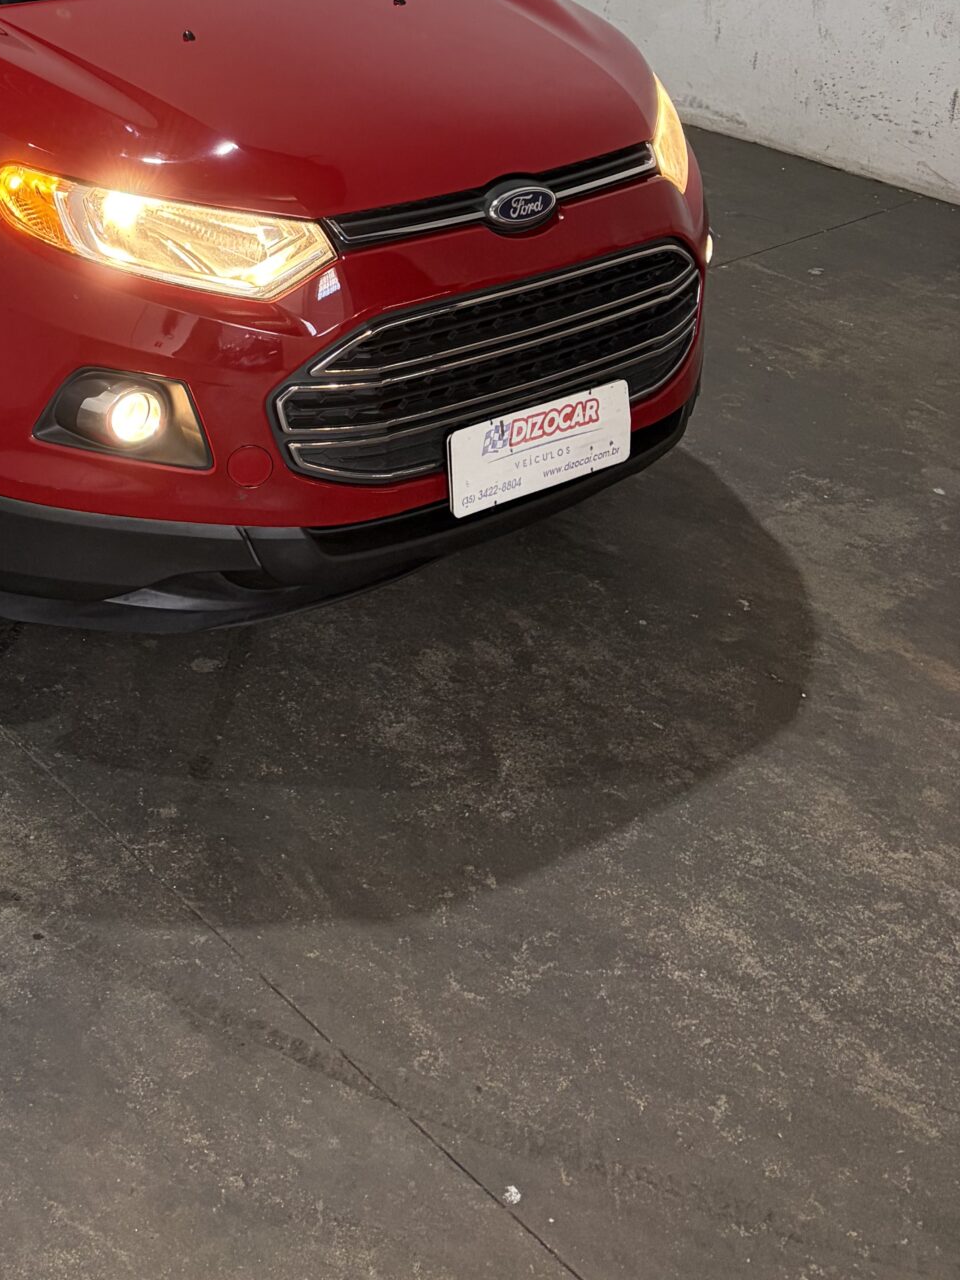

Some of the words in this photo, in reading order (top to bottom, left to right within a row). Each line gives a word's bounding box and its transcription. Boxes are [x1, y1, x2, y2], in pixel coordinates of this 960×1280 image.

[510, 194, 543, 218] Ford
[508, 398, 600, 448] DIZOCAR
[542, 446, 620, 478] www.dizocar.com.br
[461, 494, 476, 508] (35)
[478, 477, 522, 501] 3422-8804
